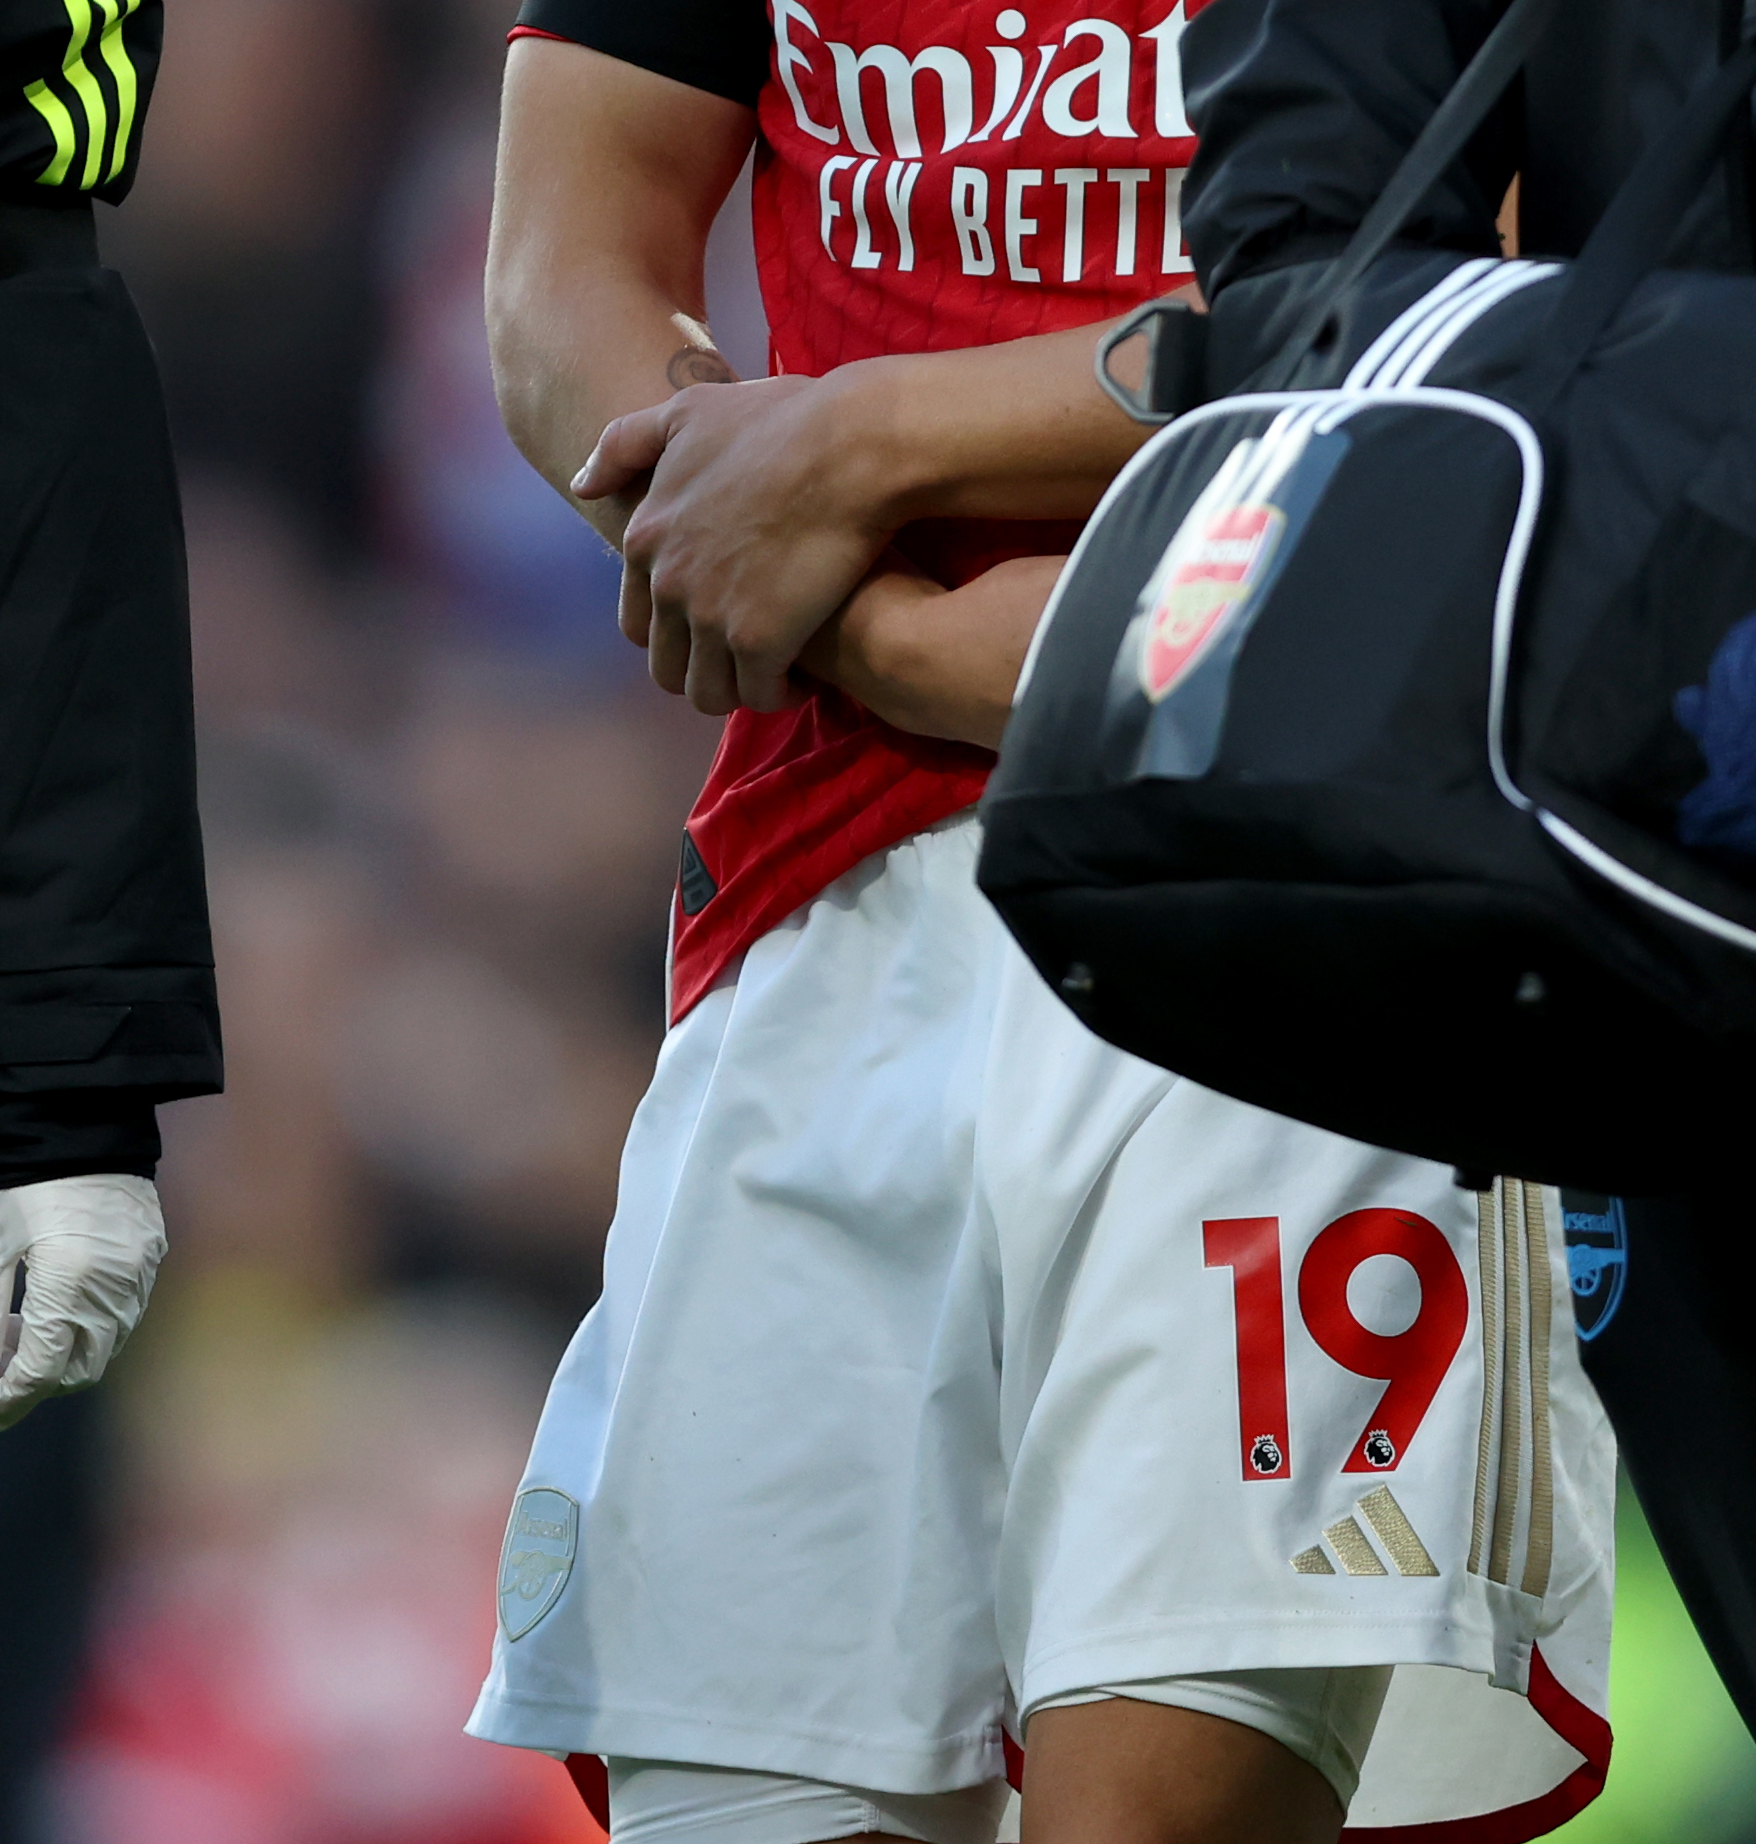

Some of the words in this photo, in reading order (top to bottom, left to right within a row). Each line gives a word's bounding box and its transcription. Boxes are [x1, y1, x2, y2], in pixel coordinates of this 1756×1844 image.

[819, 154, 924, 272] FLY
[950, 165, 1197, 283] BETTE
[1562, 1209, 1614, 1234] rsenal
[1201, 1206, 1470, 1482] 19
